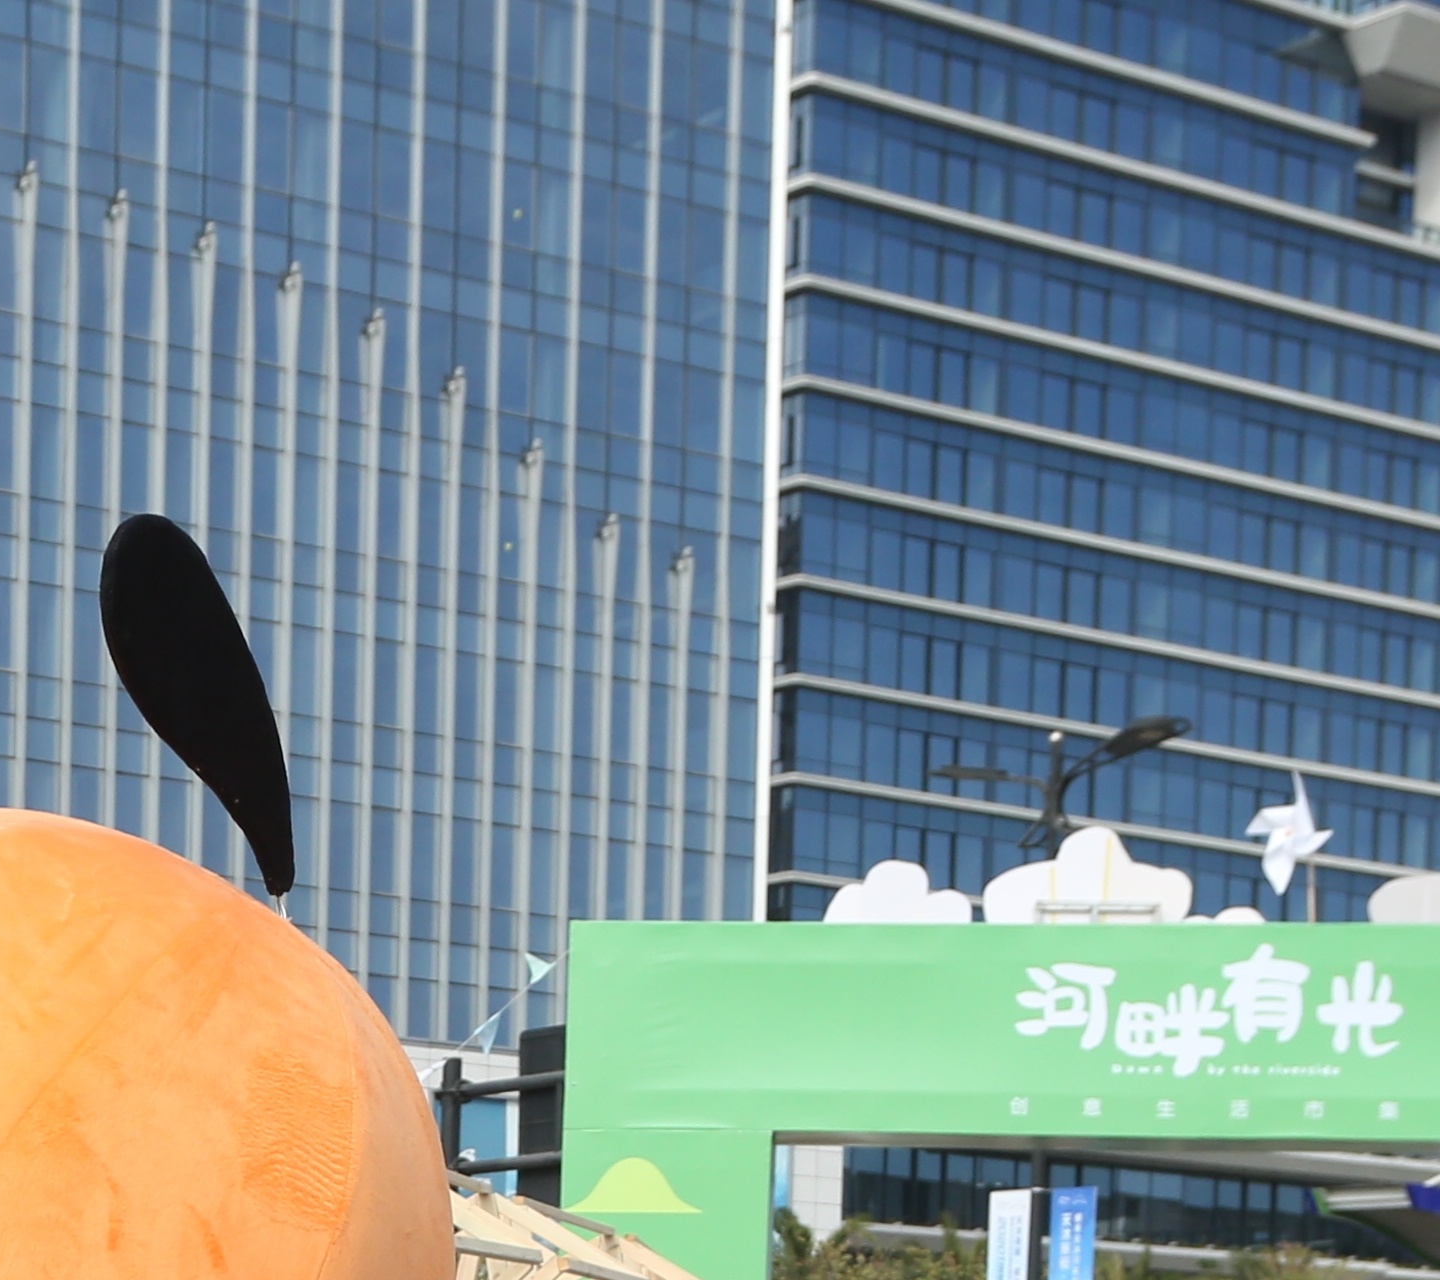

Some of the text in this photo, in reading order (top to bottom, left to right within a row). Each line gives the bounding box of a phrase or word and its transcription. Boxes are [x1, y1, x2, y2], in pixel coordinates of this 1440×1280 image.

[1014, 943, 1404, 1077] 河畔有光
[1010, 1096, 1400, 1119] 创意生活市集
